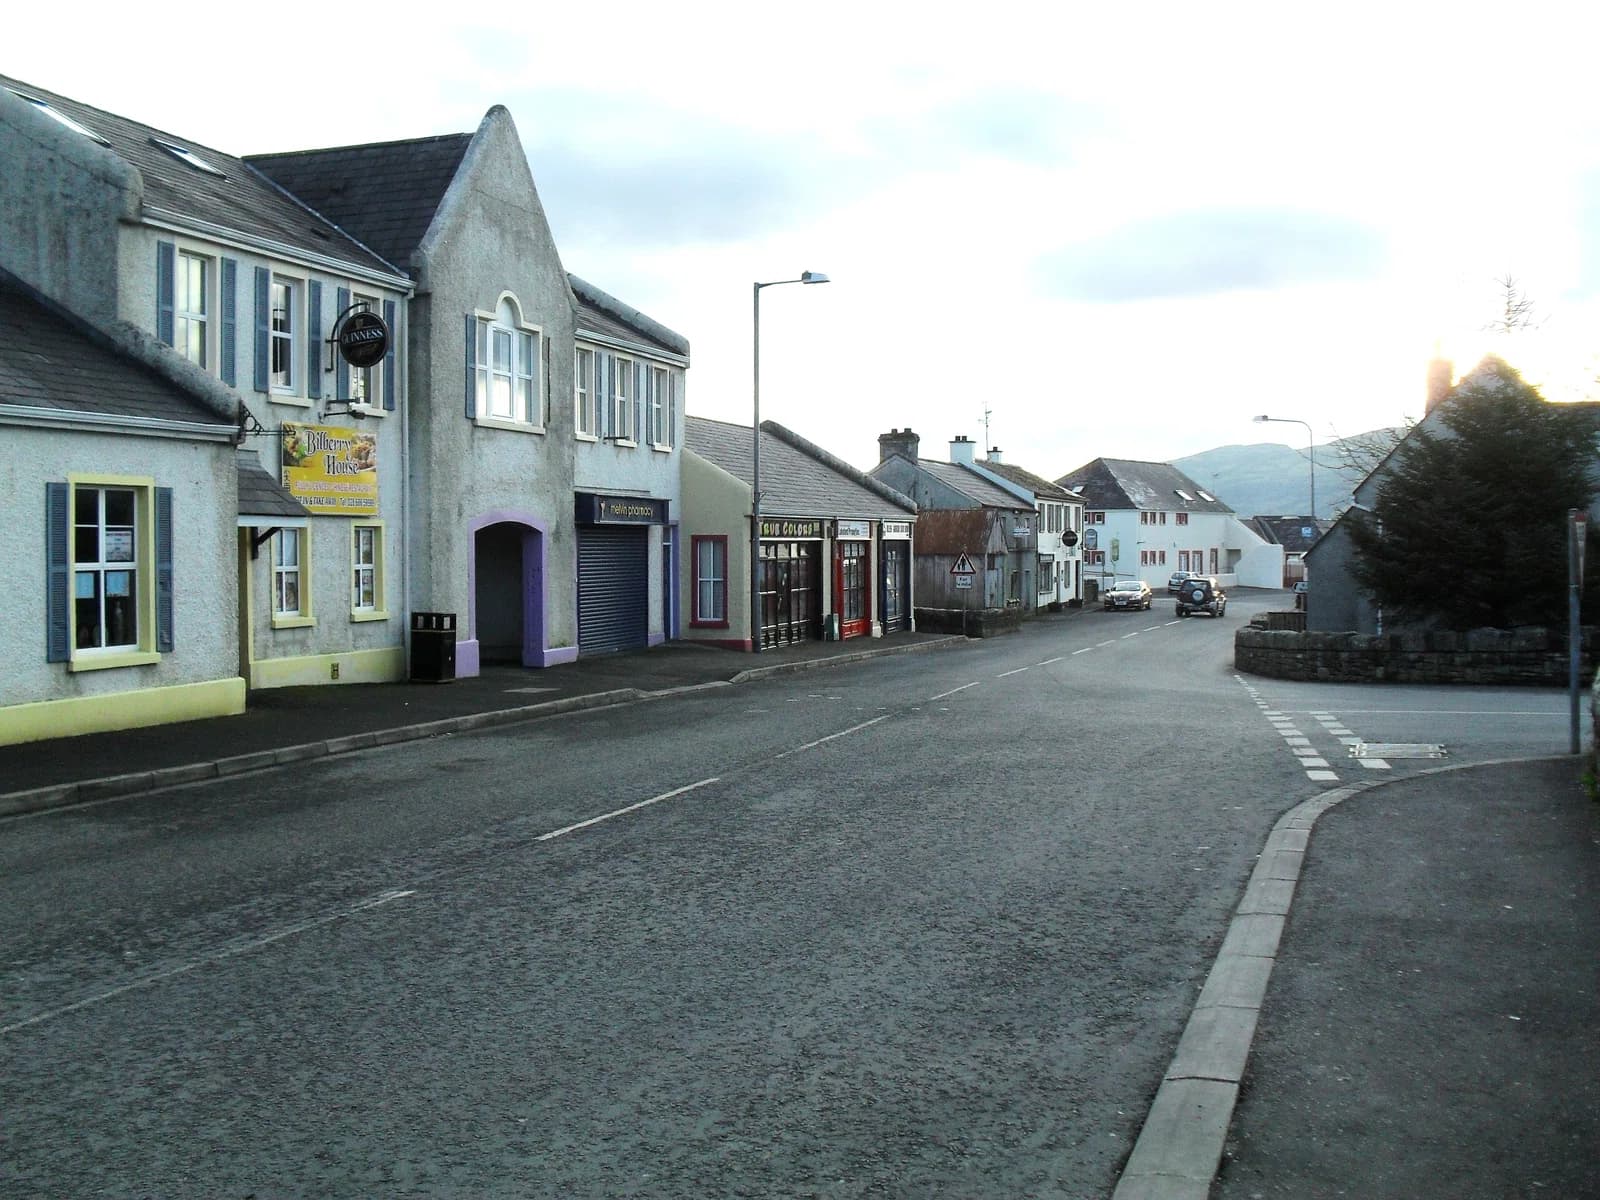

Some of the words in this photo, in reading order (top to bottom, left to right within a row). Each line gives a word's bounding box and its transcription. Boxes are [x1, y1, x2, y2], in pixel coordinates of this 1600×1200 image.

[306, 430, 352, 459] Bilberry
[326, 455, 360, 475] House
[783, 521, 813, 537] COLORS
